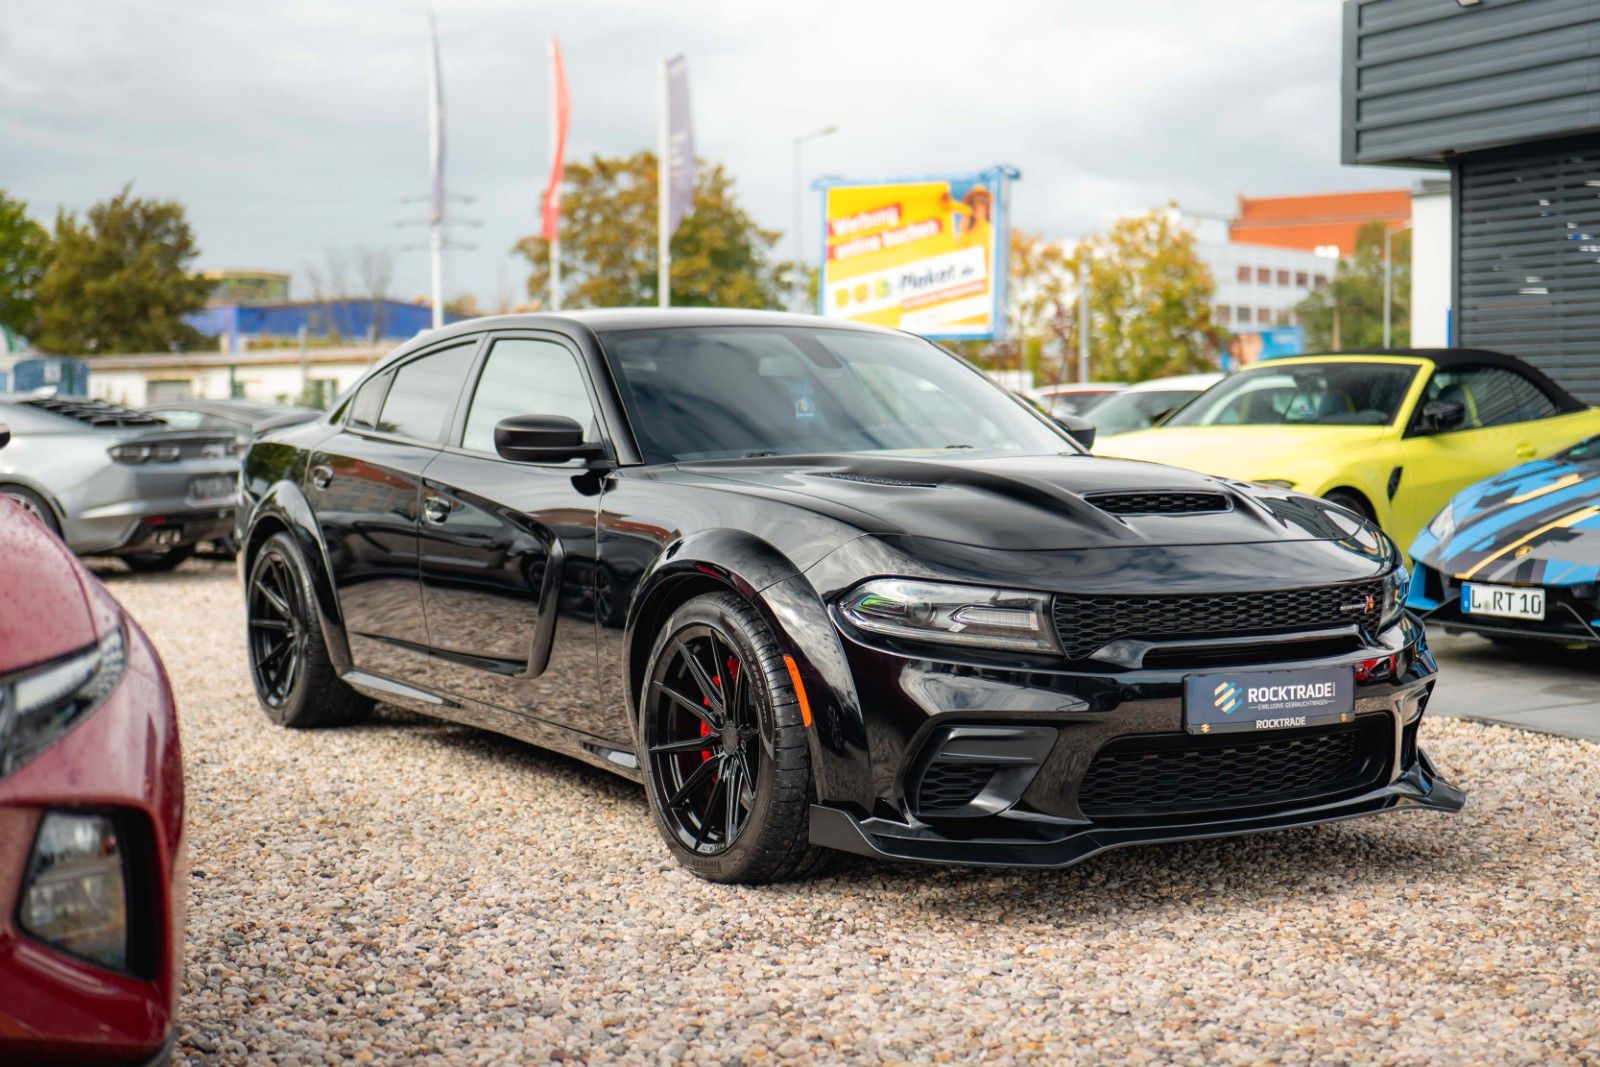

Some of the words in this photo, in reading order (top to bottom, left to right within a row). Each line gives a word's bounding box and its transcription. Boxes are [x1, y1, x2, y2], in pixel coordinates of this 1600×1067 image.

[1472, 589, 1481, 609] L
[1493, 590, 1516, 612] RT
[1520, 593, 1542, 614] 10
[1248, 682, 1332, 703] ROCKTRADE
[1257, 702, 1285, 711] EXKLUSIVE
[1255, 716, 1306, 729] ROCKTRADE
